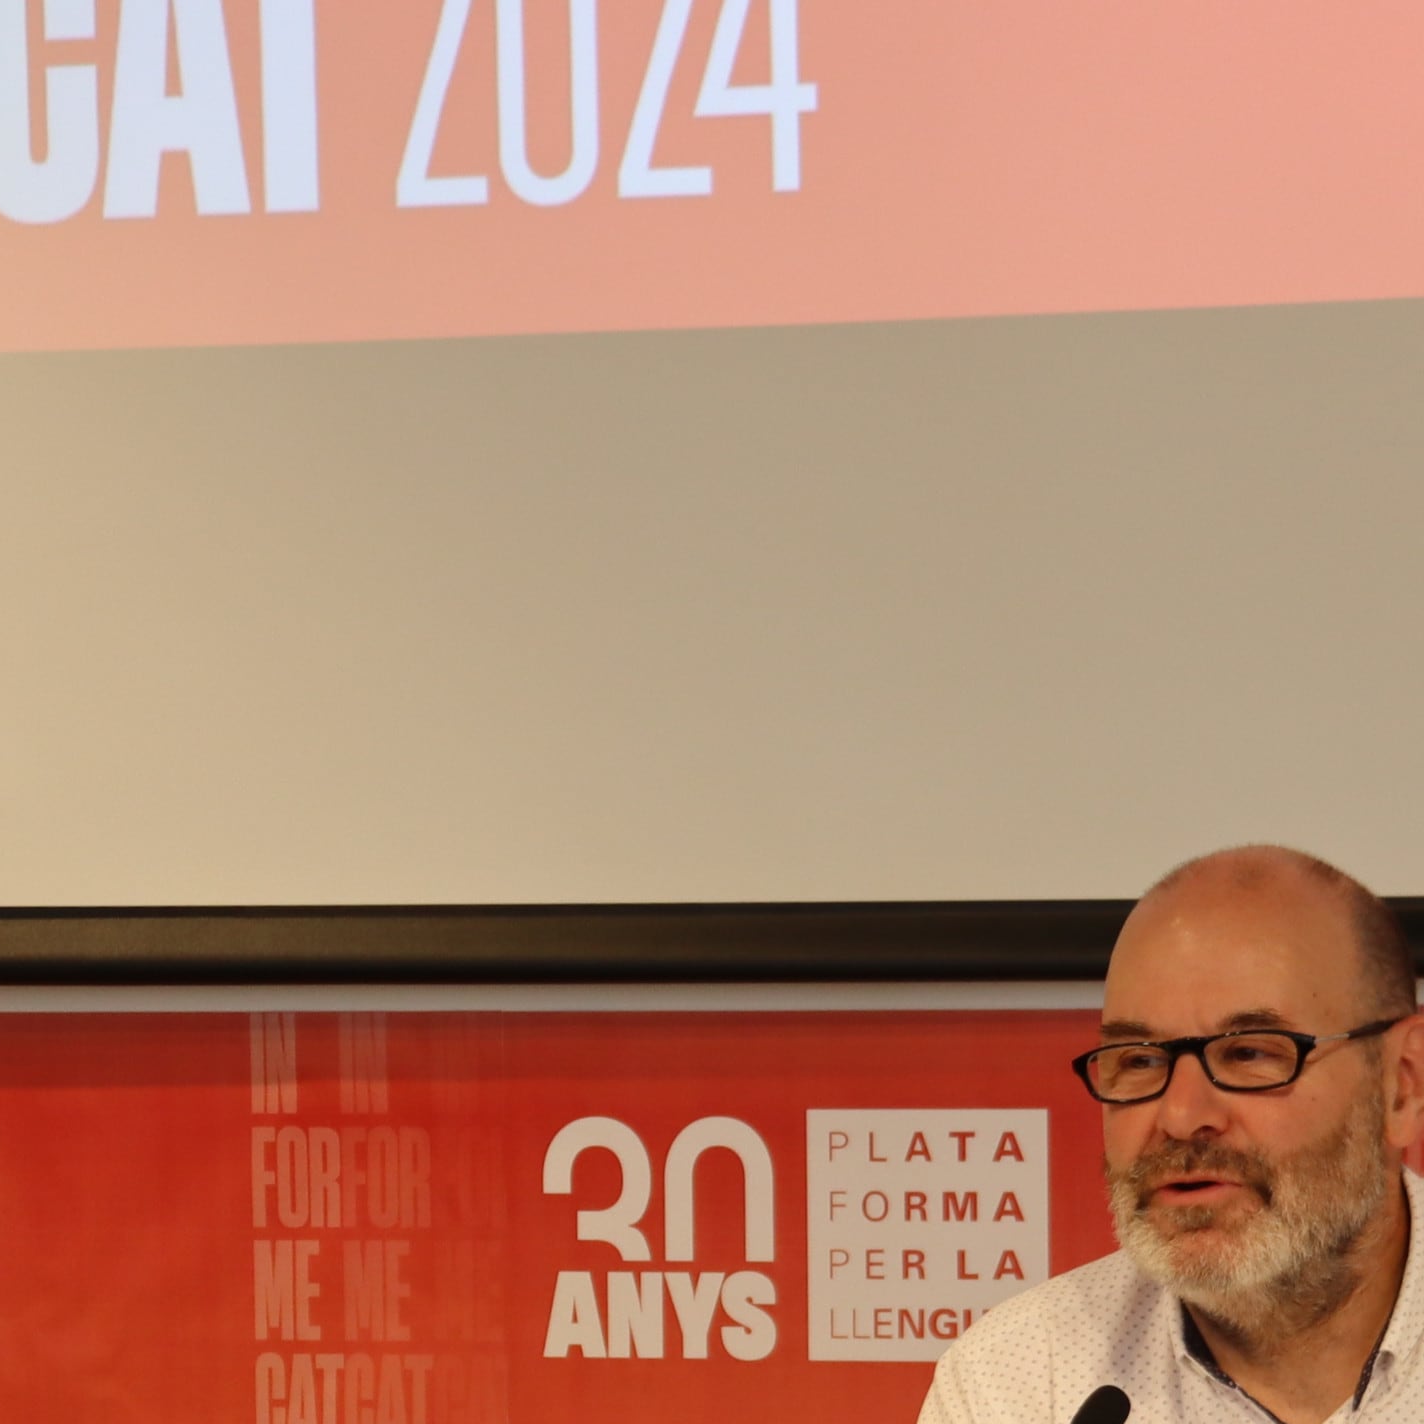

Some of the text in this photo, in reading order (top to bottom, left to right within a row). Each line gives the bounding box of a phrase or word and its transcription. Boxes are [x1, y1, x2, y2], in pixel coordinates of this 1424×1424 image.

[828, 1131, 1025, 1162] PLATA
[542, 1115, 775, 1264] 30
[829, 1190, 1025, 1222] FORMA
[830, 1249, 1025, 1280] PER LA
[542, 1270, 777, 1360] ANYS
[830, 1308, 990, 1339] LLENG
